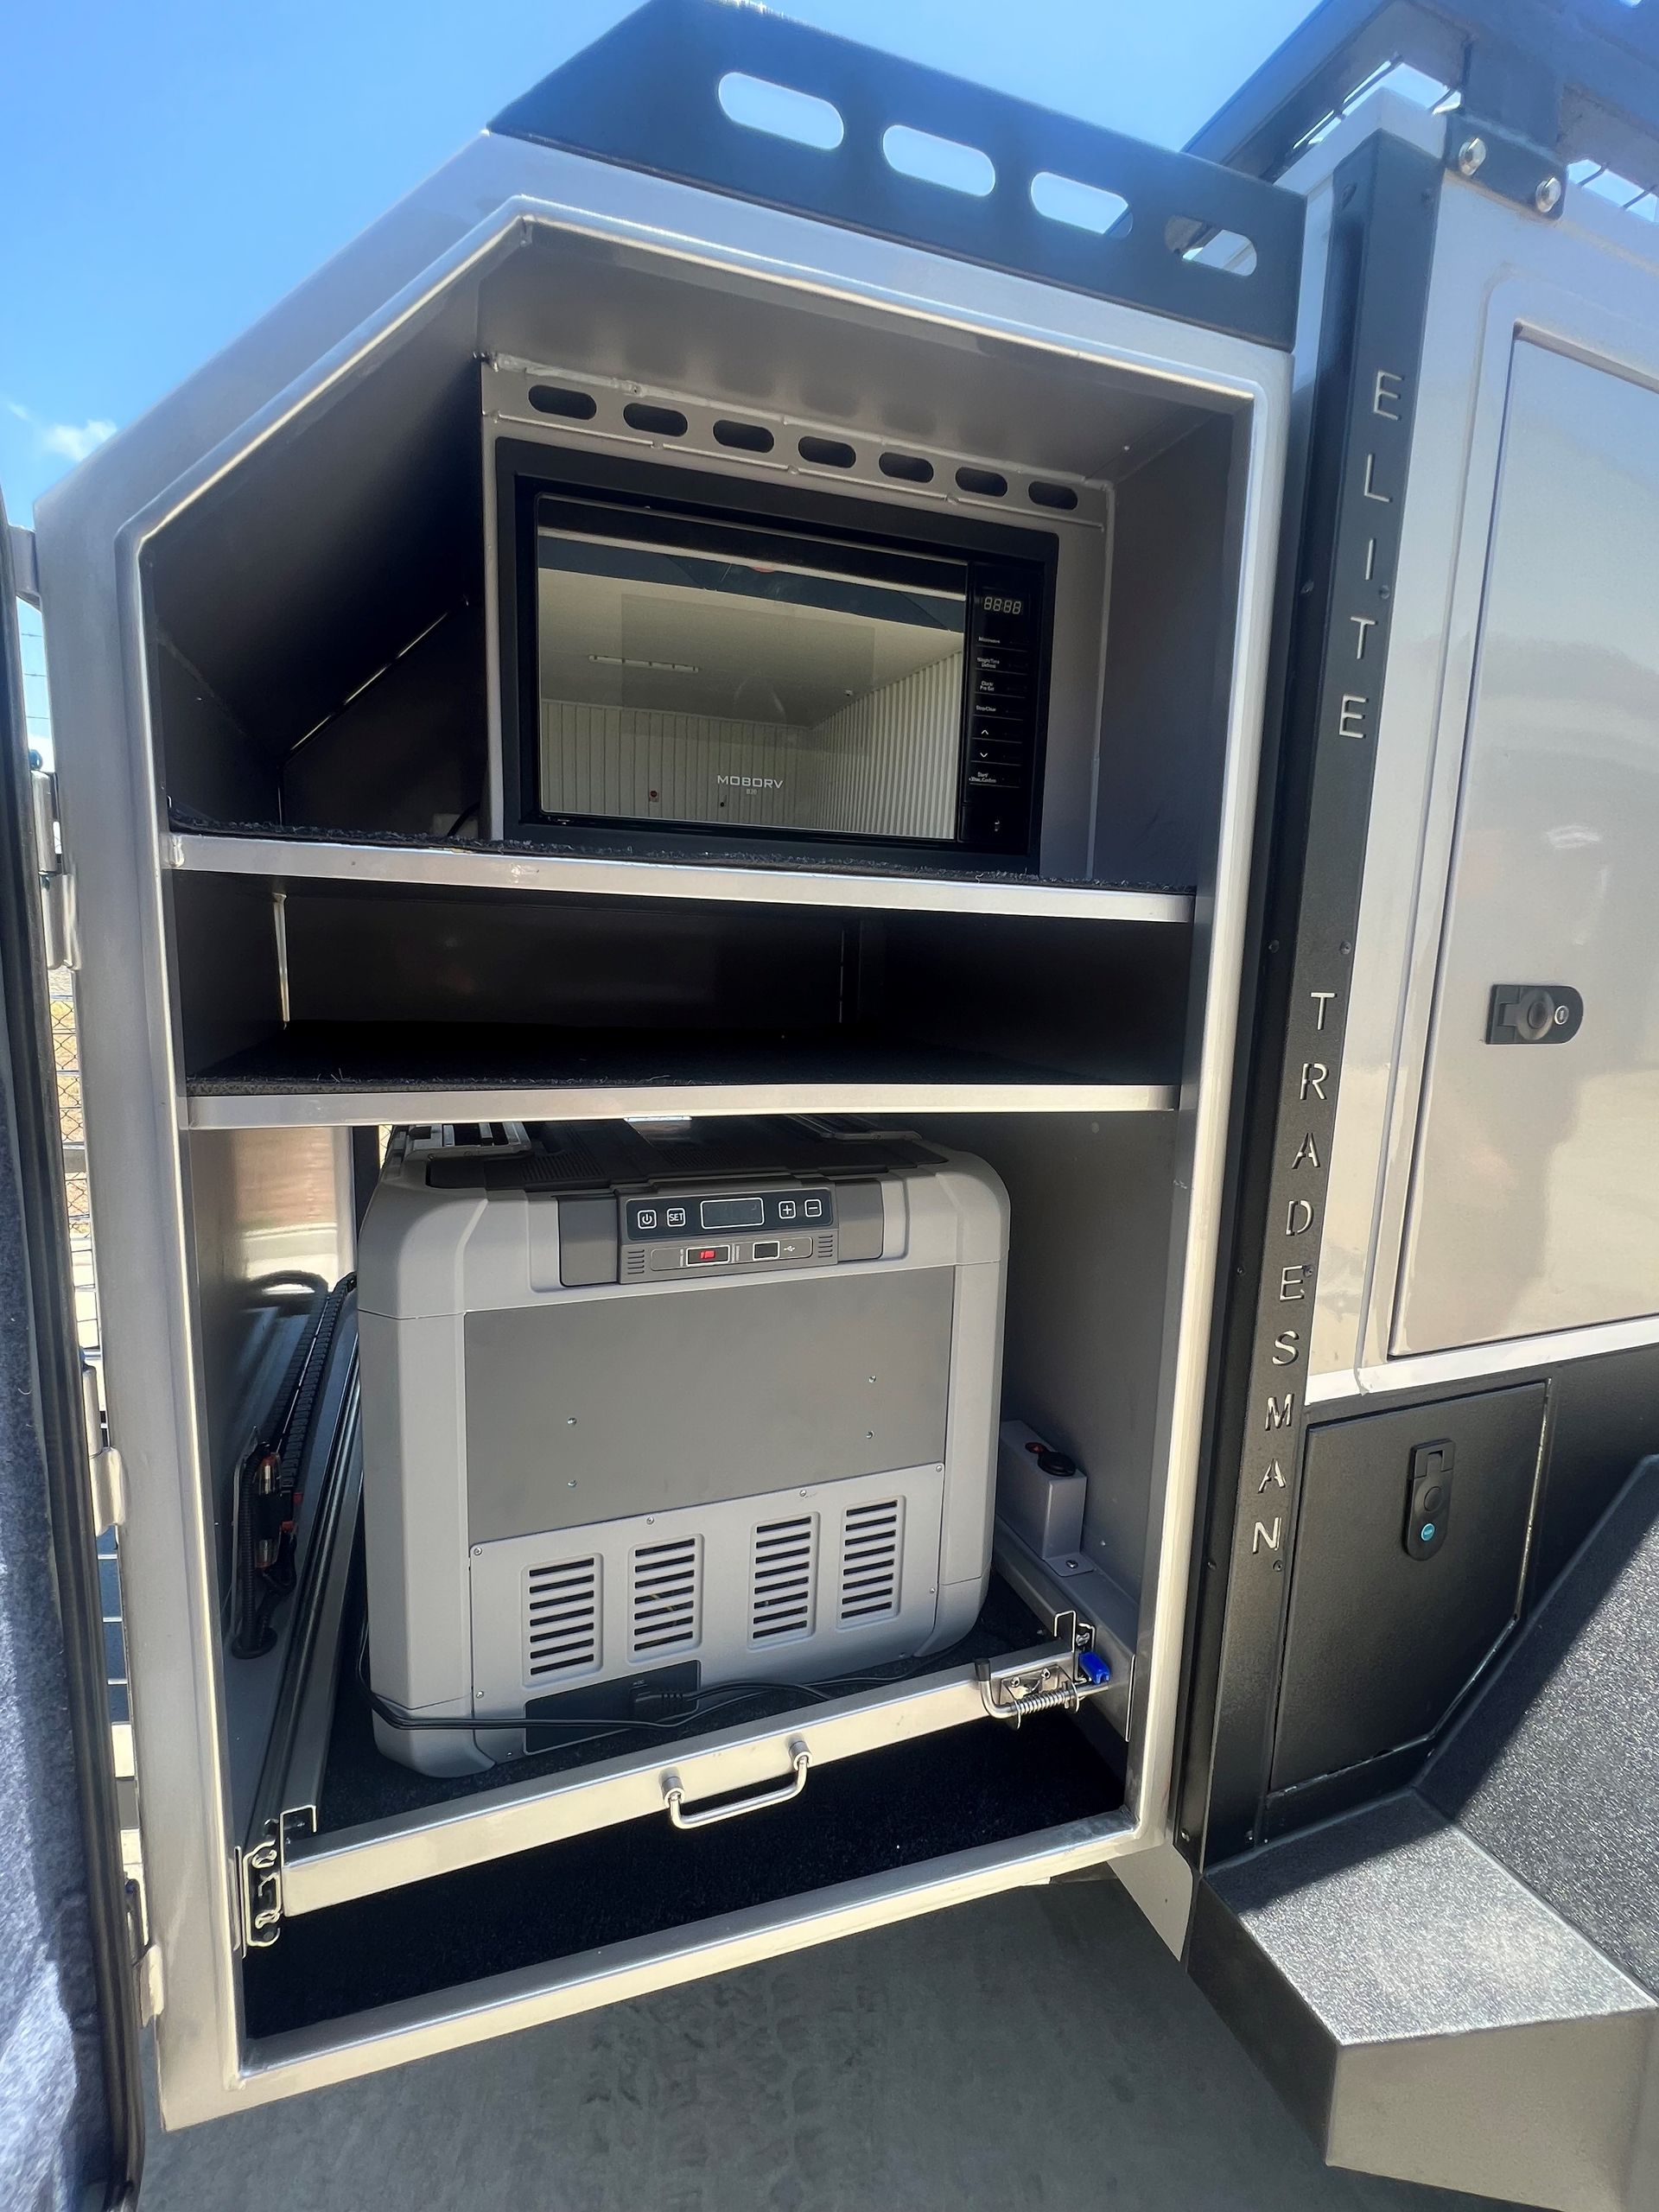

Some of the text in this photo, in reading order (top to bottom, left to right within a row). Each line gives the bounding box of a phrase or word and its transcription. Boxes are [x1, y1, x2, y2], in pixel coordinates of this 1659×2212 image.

[717, 775, 784, 789] MOBORV
[1252, 370, 1405, 1555] ELITE TRADESMAN
[669, 1212, 683, 1222] SET
